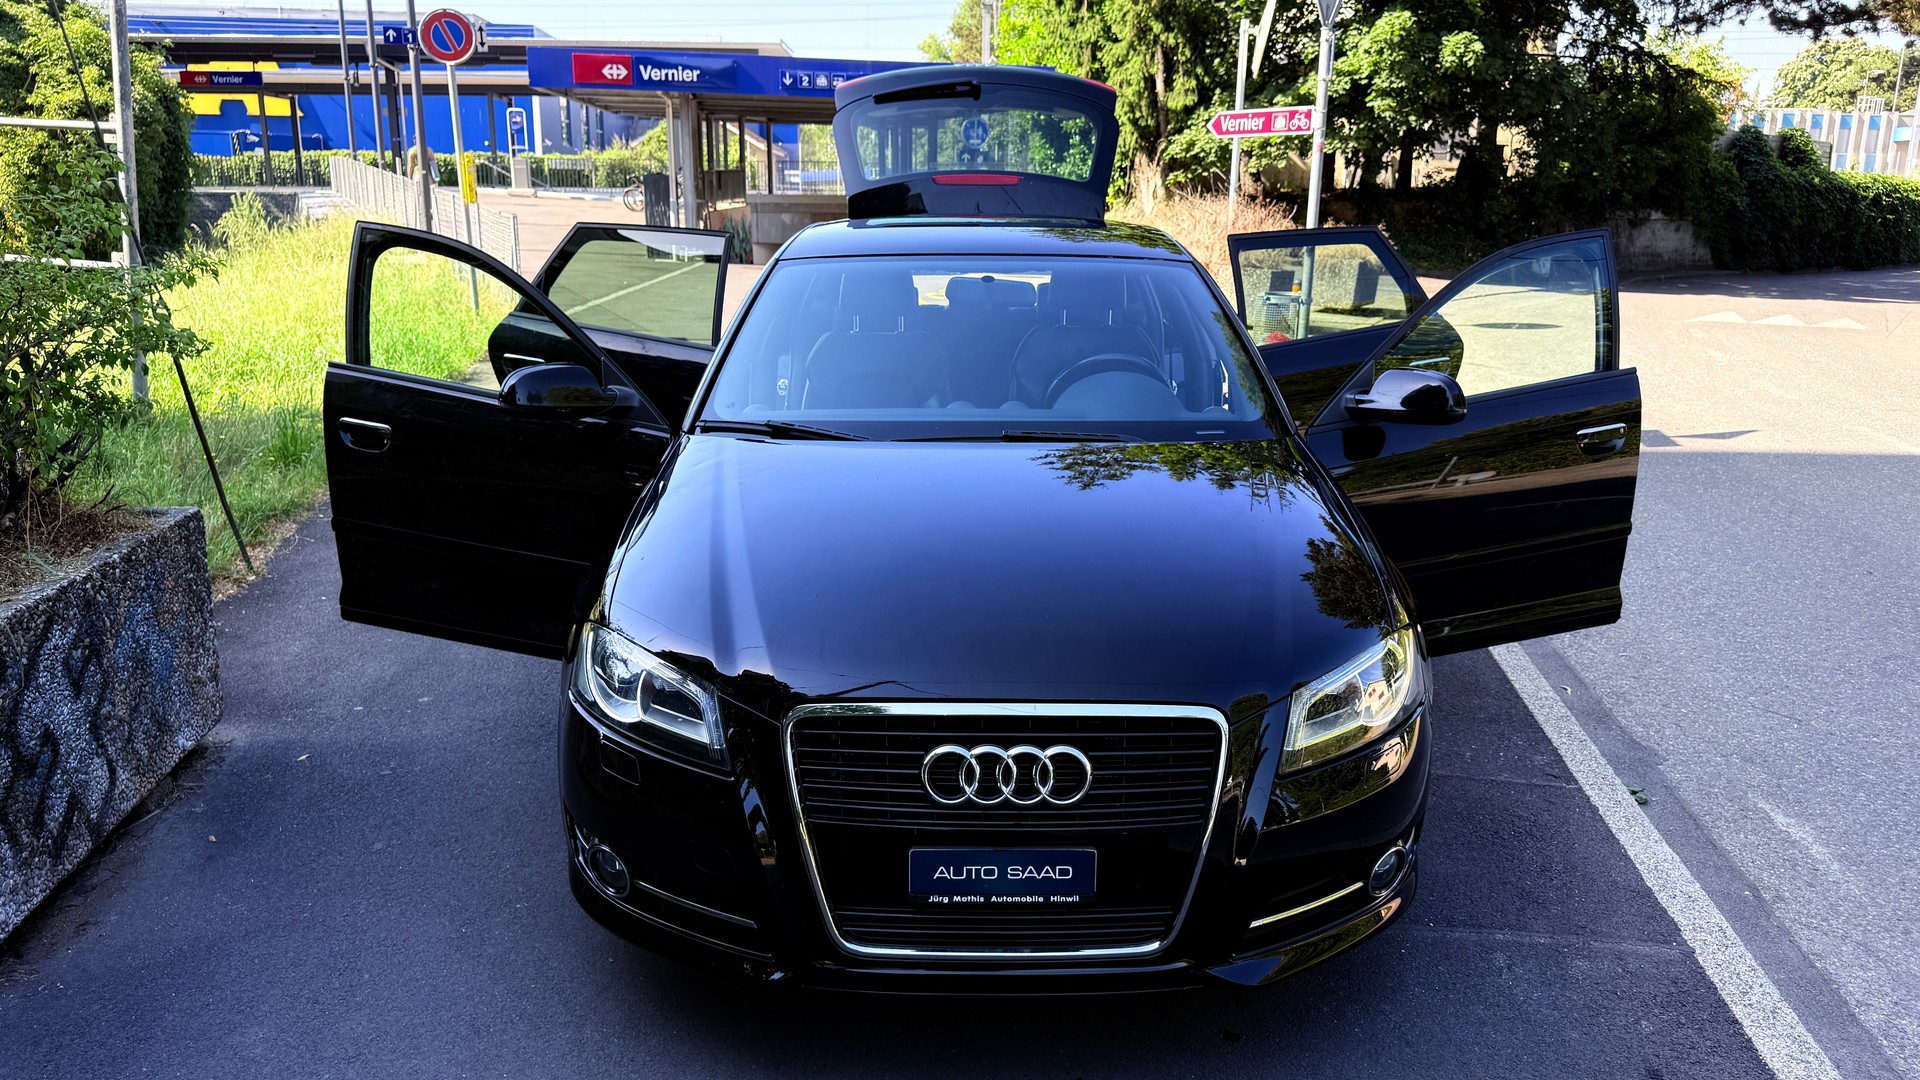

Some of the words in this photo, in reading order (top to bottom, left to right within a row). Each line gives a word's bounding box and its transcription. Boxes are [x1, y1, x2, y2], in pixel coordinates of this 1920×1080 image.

[406, 32, 413, 43] 1
[639, 64, 701, 82] Vernier
[211, 74, 243, 84] Vernier
[801, 75, 810, 87] 2
[1220, 113, 1266, 133] Vernier
[933, 866, 998, 880] AUTO
[1007, 865, 1073, 880] SAAD
[928, 895, 949, 904] Jürg
[952, 895, 985, 903] Mathis
[990, 895, 1044, 903] Automobile
[1050, 895, 1080, 903] Hinwil
